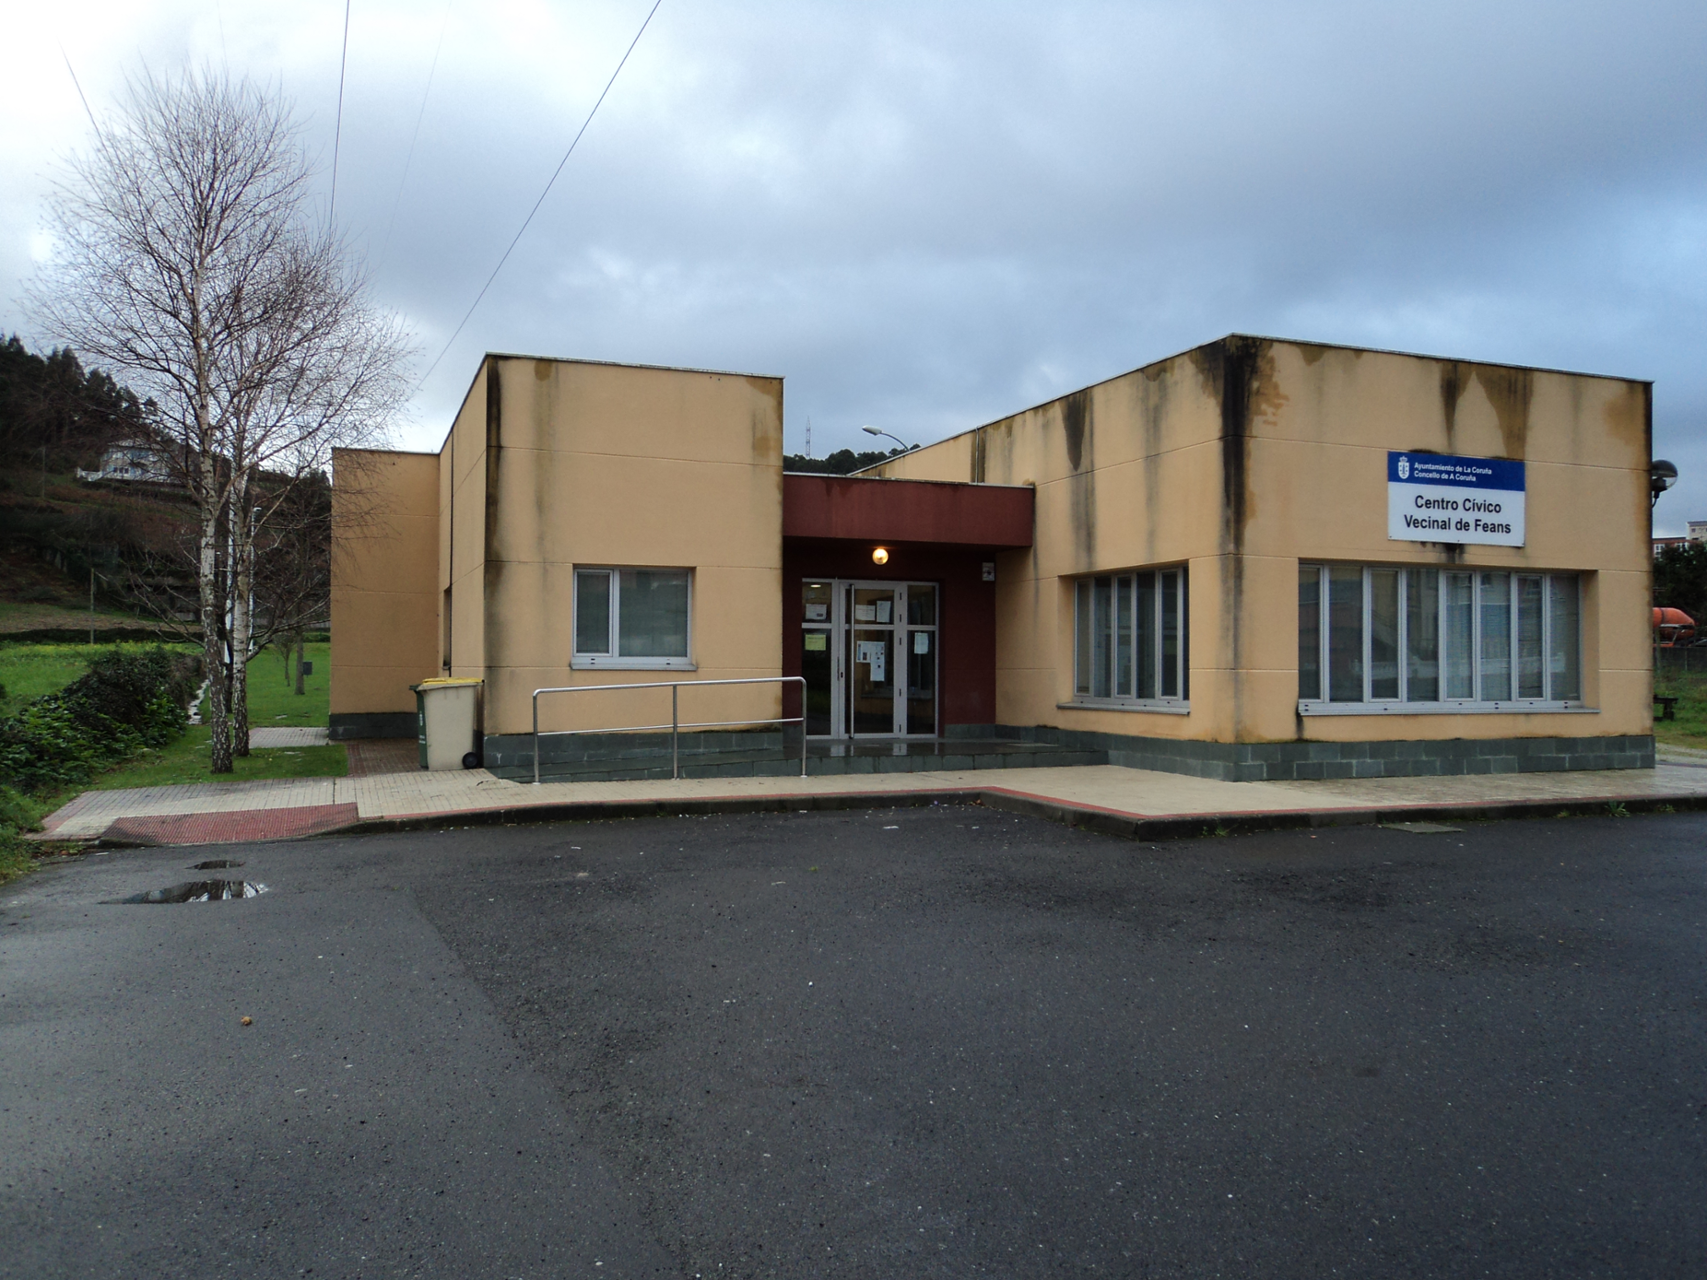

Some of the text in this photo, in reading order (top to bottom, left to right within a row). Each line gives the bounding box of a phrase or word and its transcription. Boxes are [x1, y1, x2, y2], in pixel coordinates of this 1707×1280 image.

[1414, 462, 1454, 472] Ayuntamiento
[1414, 471, 1440, 479] Concello
[1415, 495, 1502, 513] Centro Cívico
[1404, 514, 1511, 534] Vecinal de Feans
